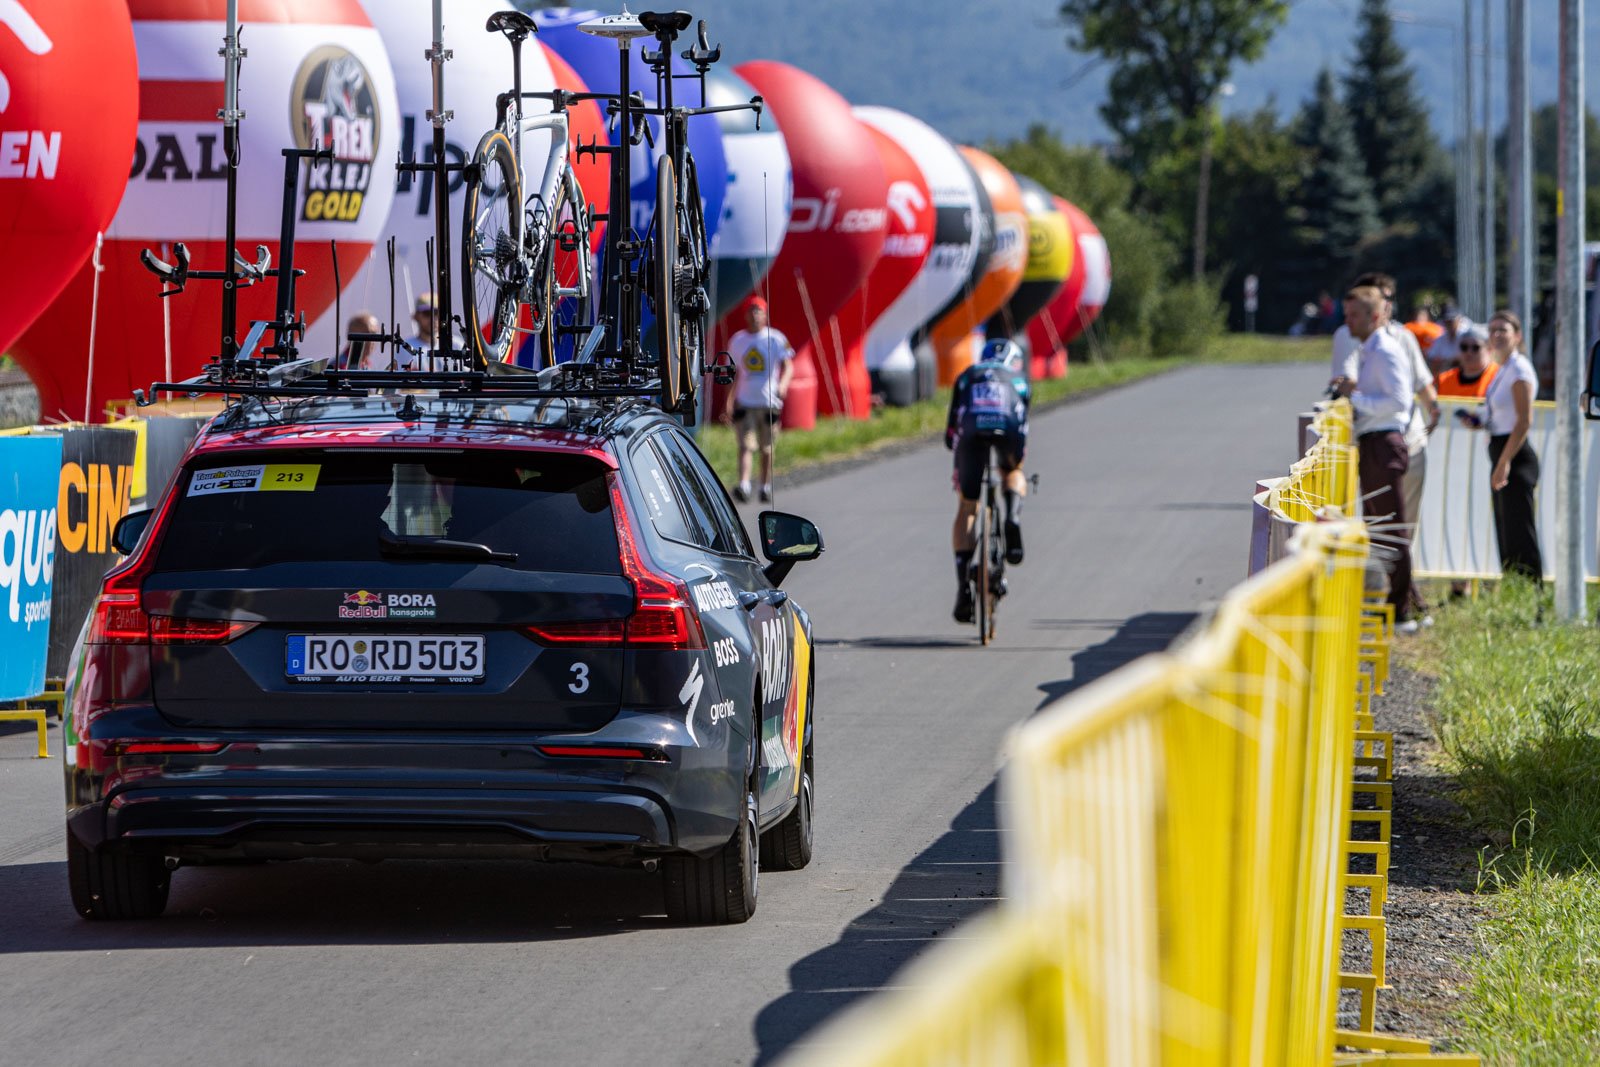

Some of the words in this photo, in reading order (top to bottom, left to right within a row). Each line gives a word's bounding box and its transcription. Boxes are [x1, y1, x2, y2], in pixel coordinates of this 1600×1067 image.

[308, 162, 371, 190] KLEJ
[304, 190, 365, 221] GOLD
[194, 482, 216, 491] UCI
[276, 472, 304, 483] 213
[388, 594, 437, 607] BORA
[389, 608, 435, 618] hansgrohe
[292, 659, 299, 668] D
[308, 639, 349, 670] RO
[713, 637, 740, 668] BOSS
[761, 616, 788, 705] BORA
[567, 662, 590, 694] 3
[710, 698, 735, 726] grenke
